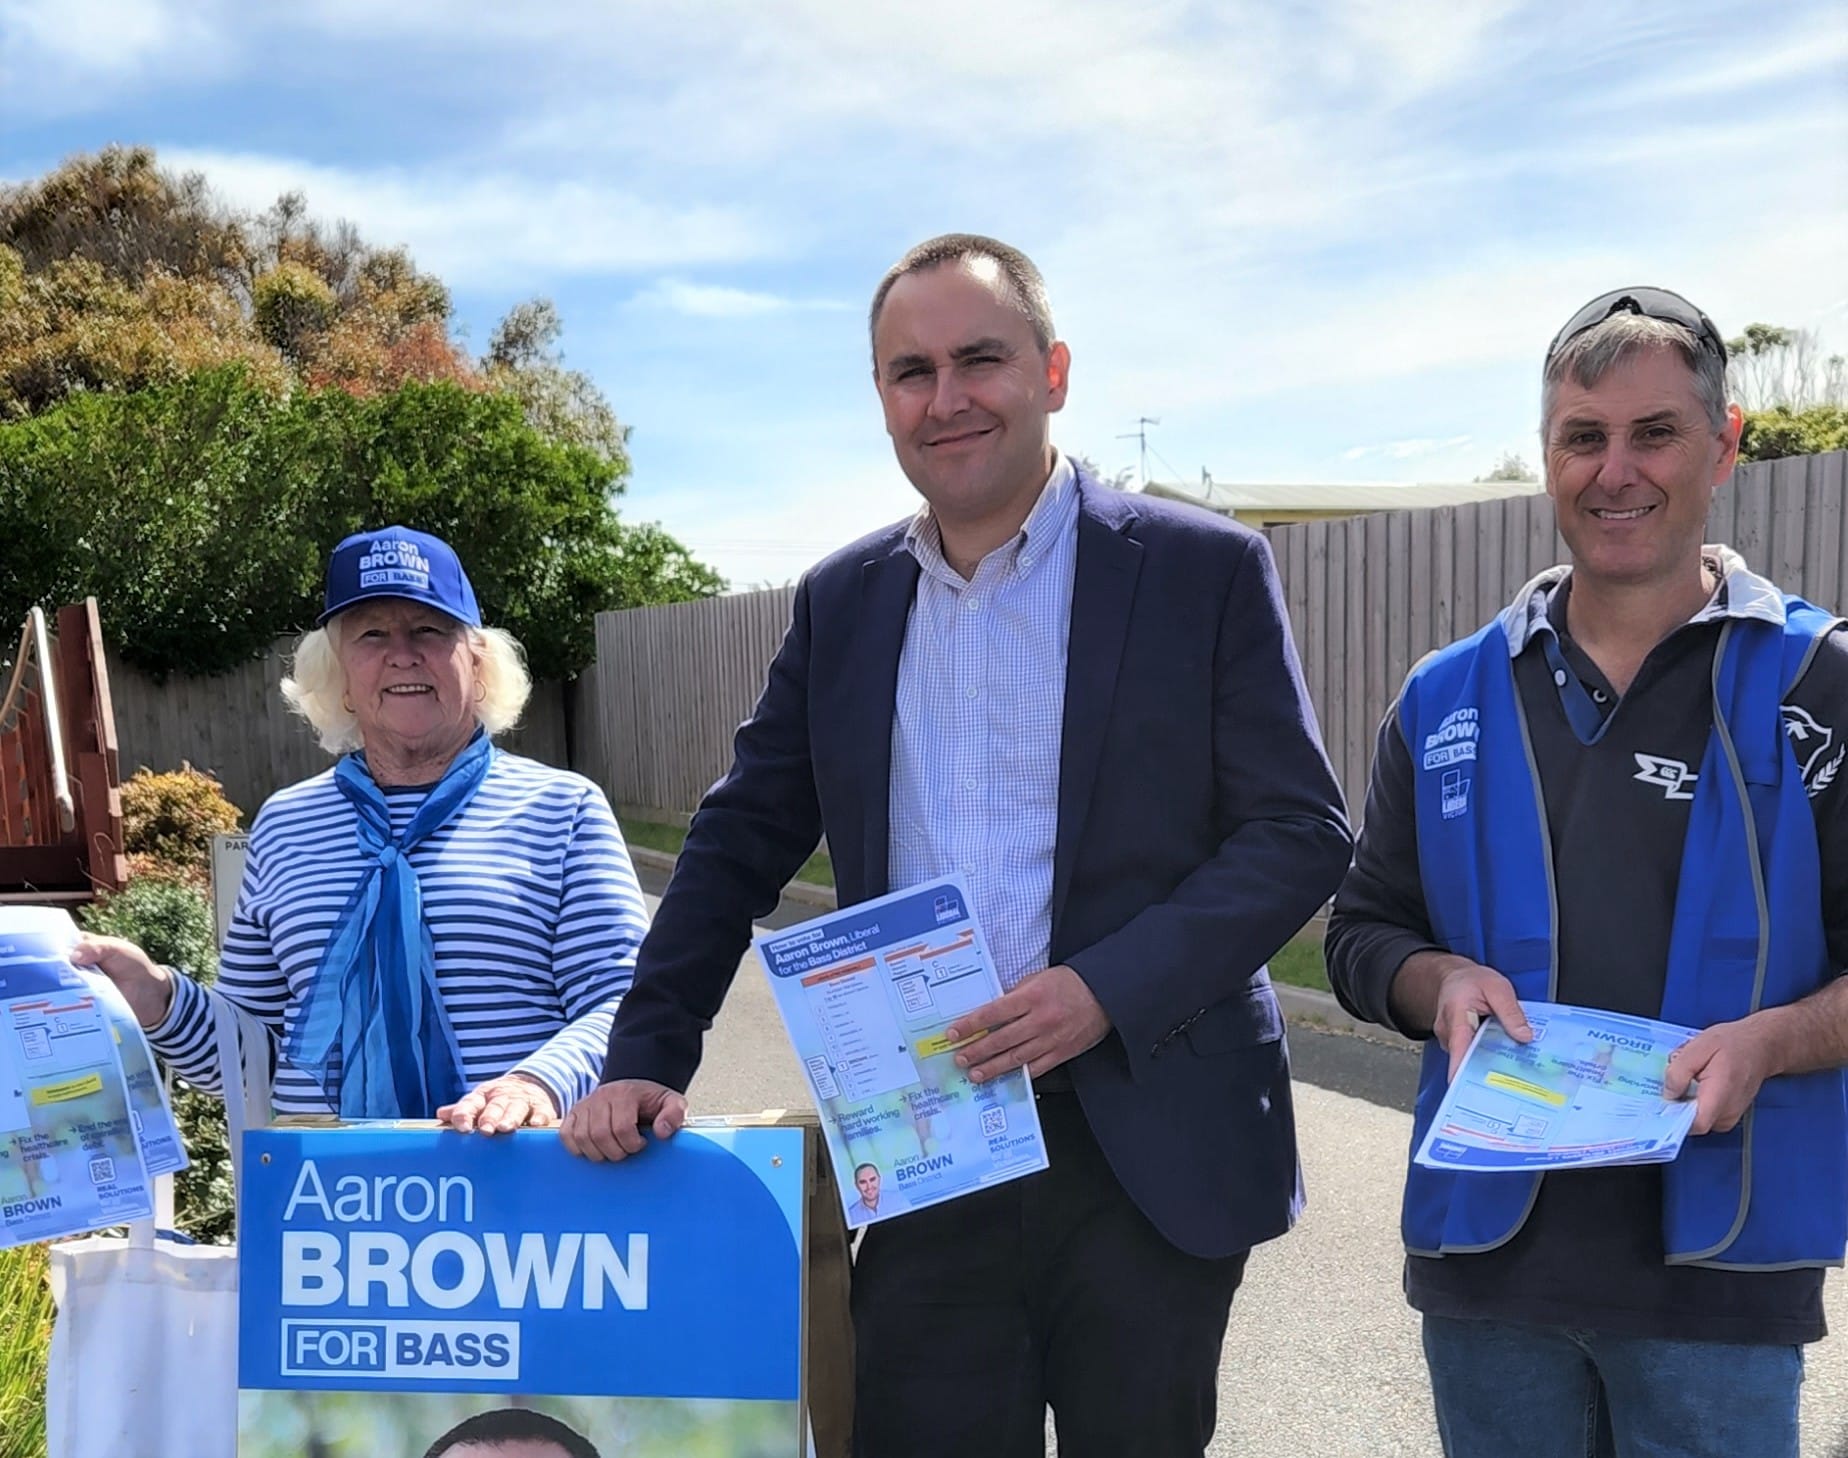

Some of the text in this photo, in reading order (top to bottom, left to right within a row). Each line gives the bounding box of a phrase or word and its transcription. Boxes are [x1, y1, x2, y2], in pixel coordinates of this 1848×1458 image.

[369, 540, 419, 555] Aaron
[359, 551, 430, 573] BROWN
[364, 571, 388, 583] FOR
[1427, 751, 1449, 766] FOR
[775, 947, 810, 966] Aaron
[849, 923, 881, 941] Liberal
[808, 953, 833, 967] Bass
[832, 941, 868, 957] District
[1586, 1029, 1654, 1052] BROWN
[910, 1090, 960, 1111] healthcare
[923, 1086, 940, 1098] the
[863, 1108, 901, 1124] working
[990, 1132, 1036, 1154] SOLUTIONS
[895, 1152, 954, 1183] BROWN
[282, 1158, 474, 1222] Aaron
[3, 1195, 63, 1219] BROWN
[281, 1230, 649, 1311] BROWN
[295, 1329, 511, 1368] FOR BASS
